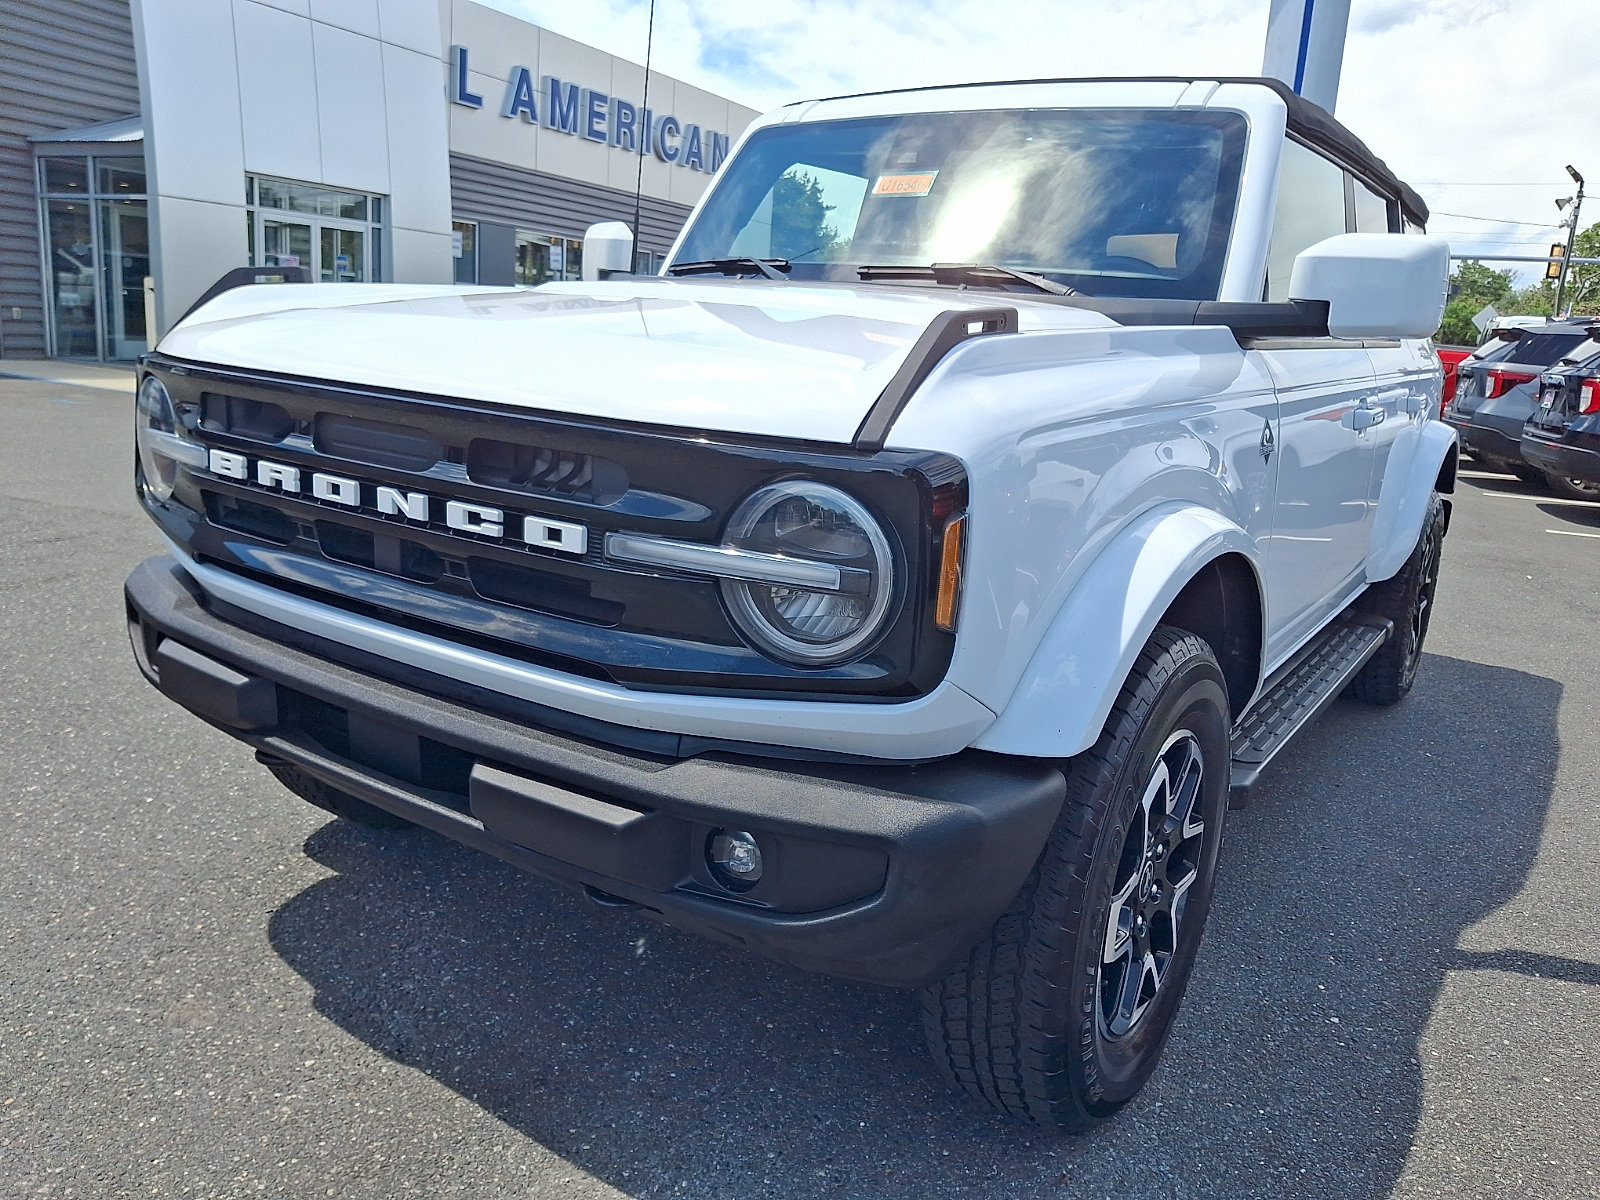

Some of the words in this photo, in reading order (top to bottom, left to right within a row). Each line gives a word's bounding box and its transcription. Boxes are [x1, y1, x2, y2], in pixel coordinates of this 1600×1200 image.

[451, 44, 483, 109] L
[501, 65, 730, 174] AMERICAN
[208, 448, 589, 555] BRONCO
